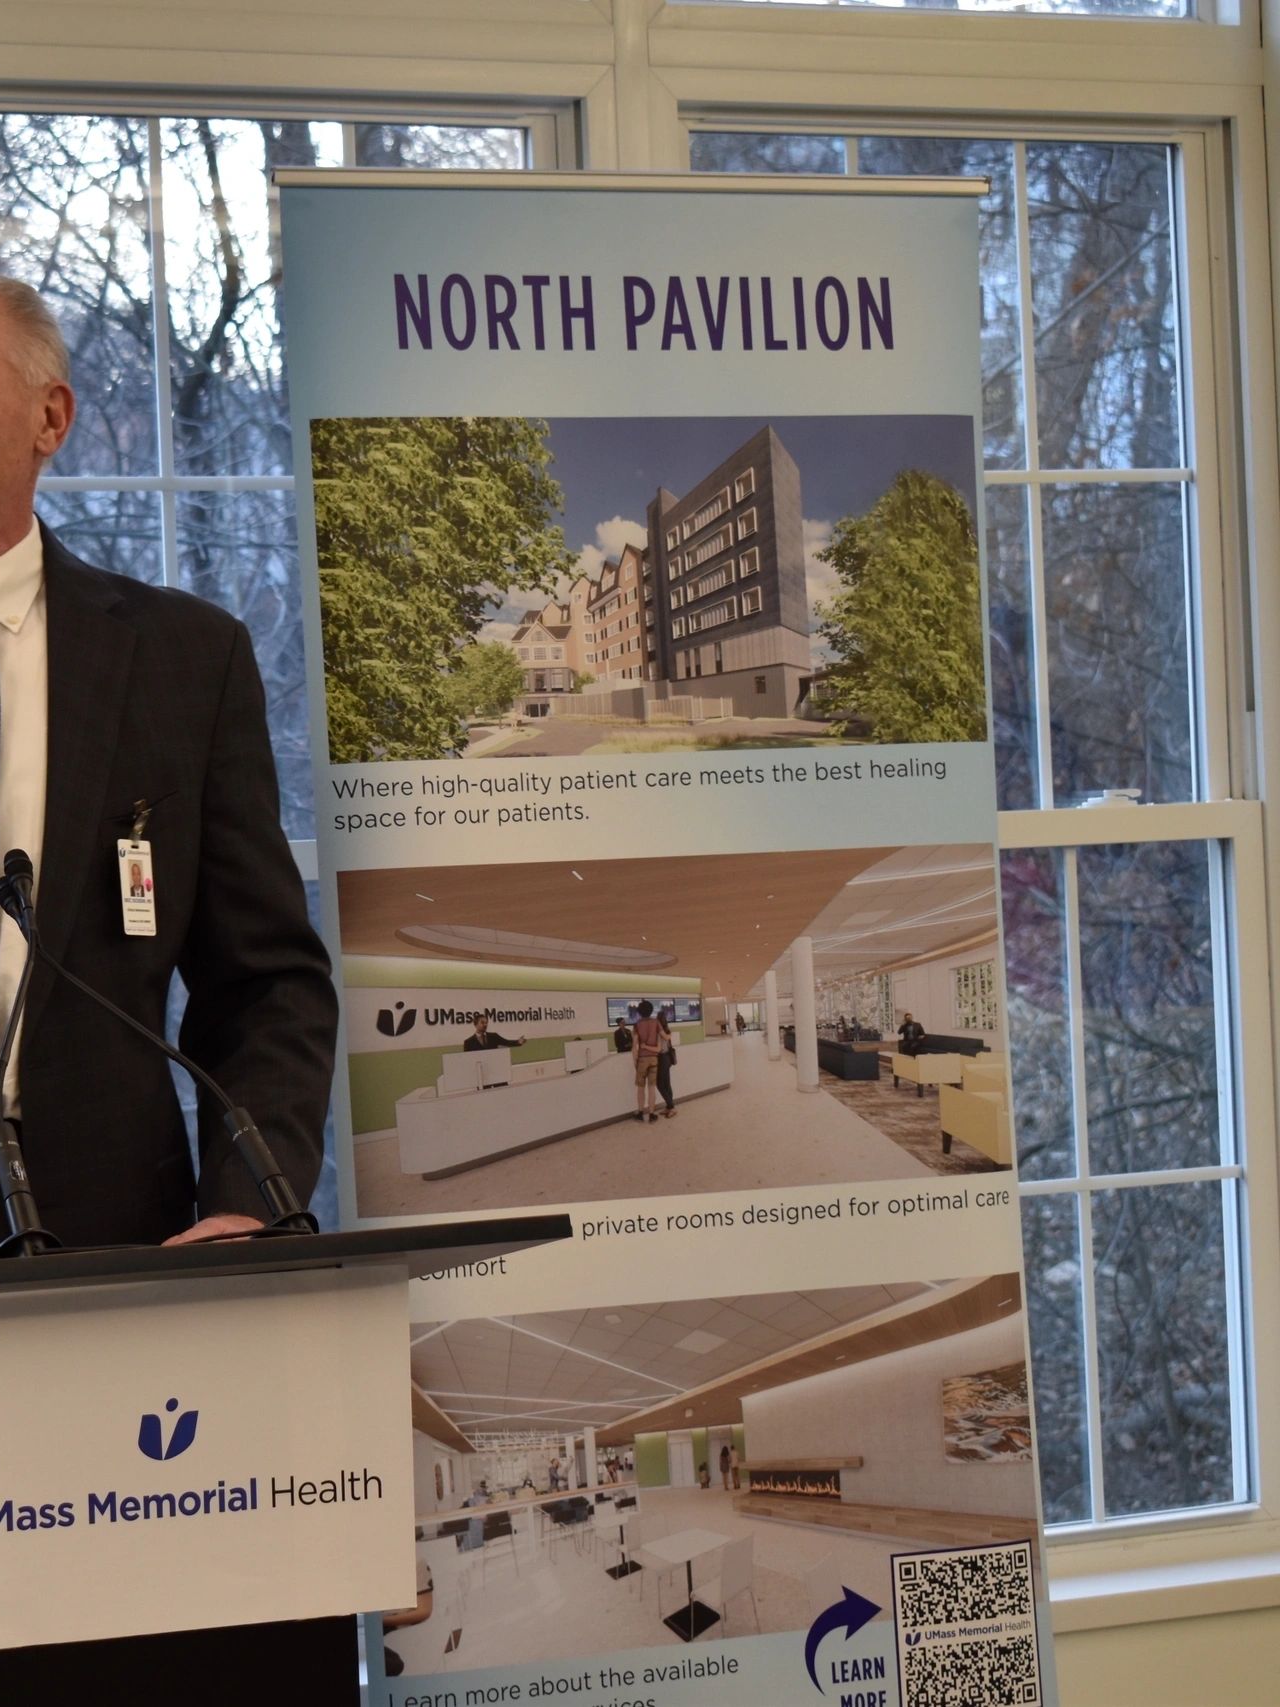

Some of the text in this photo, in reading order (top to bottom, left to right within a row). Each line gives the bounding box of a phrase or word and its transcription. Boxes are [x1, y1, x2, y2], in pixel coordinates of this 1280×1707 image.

[394, 274, 894, 351] NORTH PAVILION
[332, 758, 946, 799] Where high-quality patient care meets the best healing
[335, 802, 589, 833] space for our patients.
[485, 1006, 542, 1023] Memorial
[545, 1005, 575, 1020] Health
[583, 1190, 1009, 1240] private rooms designed for optimal care
[88, 1478, 257, 1524] Memorial
[272, 1468, 382, 1508] Health
[925, 1620, 1032, 1640] UMass Memorial Health
[466, 1685, 520, 1705] more
[529, 1672, 592, 1697] about
[600, 1668, 634, 1688] the
[643, 1655, 738, 1683] available
[832, 1656, 885, 1684] LEARN
